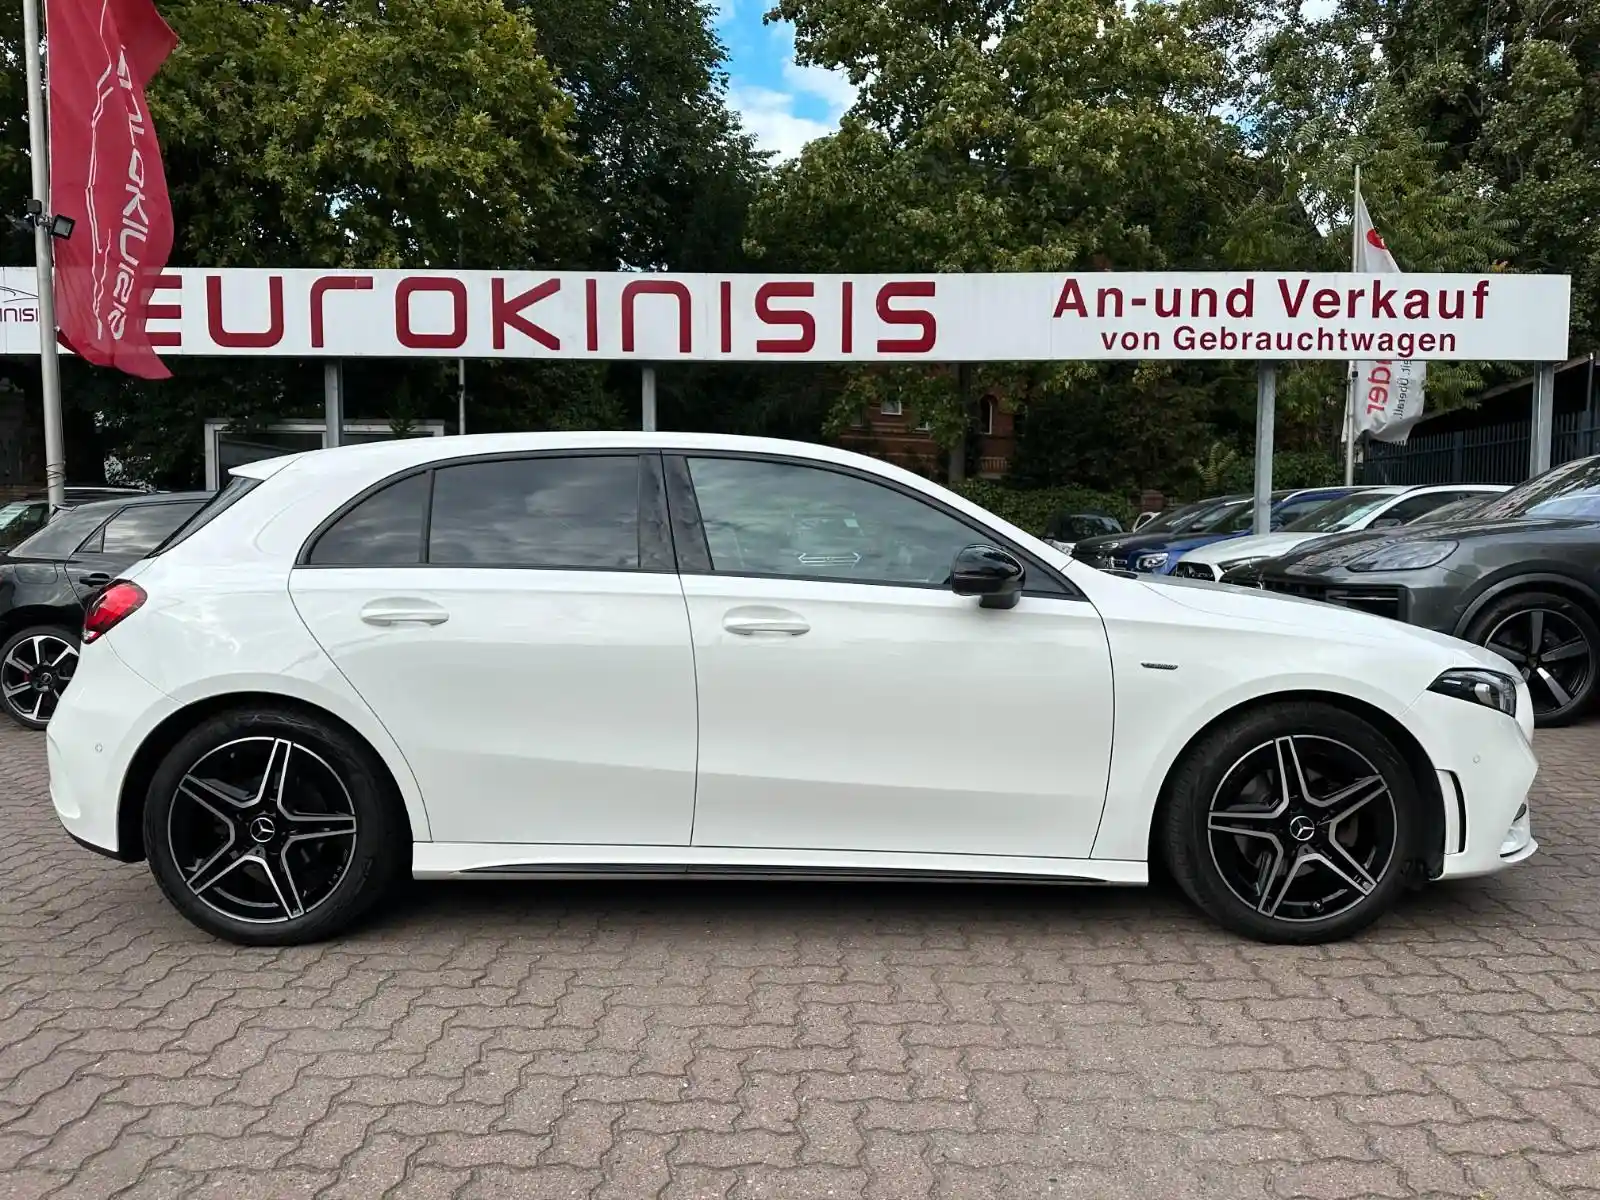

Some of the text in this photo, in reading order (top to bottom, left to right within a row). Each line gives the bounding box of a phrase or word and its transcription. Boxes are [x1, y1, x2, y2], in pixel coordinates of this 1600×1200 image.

[1053, 278, 1490, 319] An-und Verkauf
[1101, 326, 1456, 358] von Gebrauchtwagen
